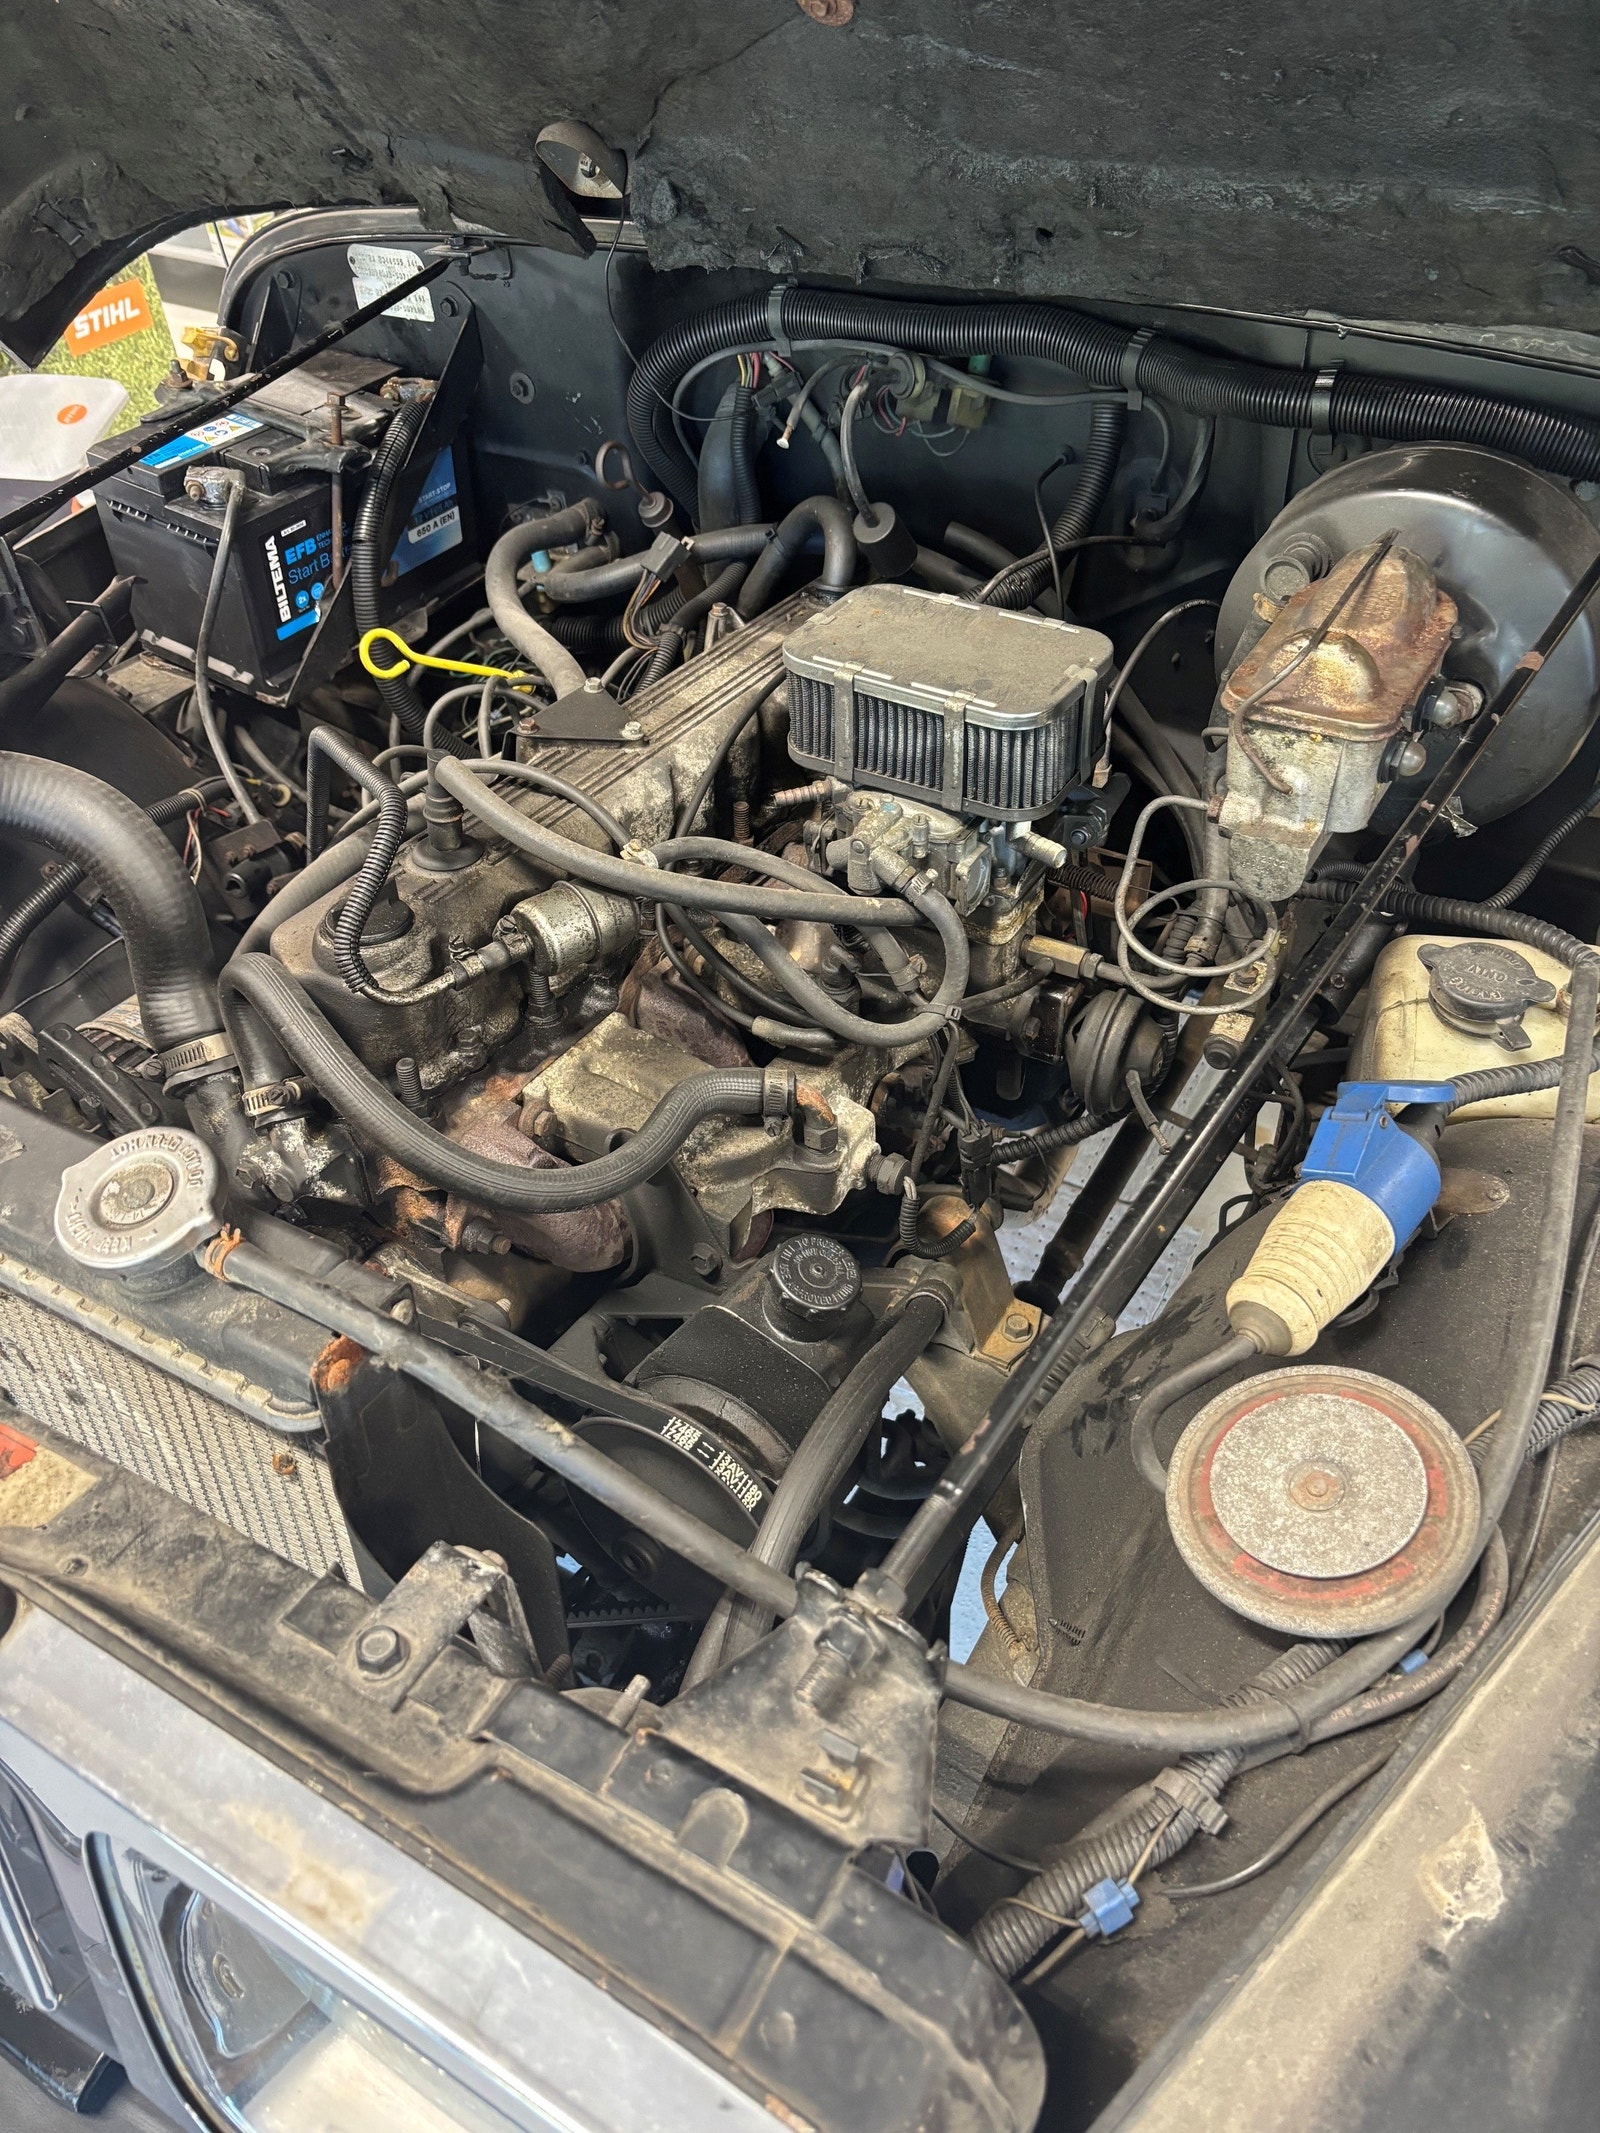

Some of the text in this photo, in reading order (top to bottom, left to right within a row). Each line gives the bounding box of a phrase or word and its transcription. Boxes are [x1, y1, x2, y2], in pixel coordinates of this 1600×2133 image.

[74, 297, 141, 340] STIHL
[417, 511, 455, 537] 650 A (EN)
[284, 537, 317, 565] EFB
[264, 535, 292, 623] BILTEMA
[288, 560, 319, 585] Start
[110, 1138, 140, 1161] HOT
[142, 1134, 184, 1151] OPEN
[93, 1236, 133, 1254] KEEP
